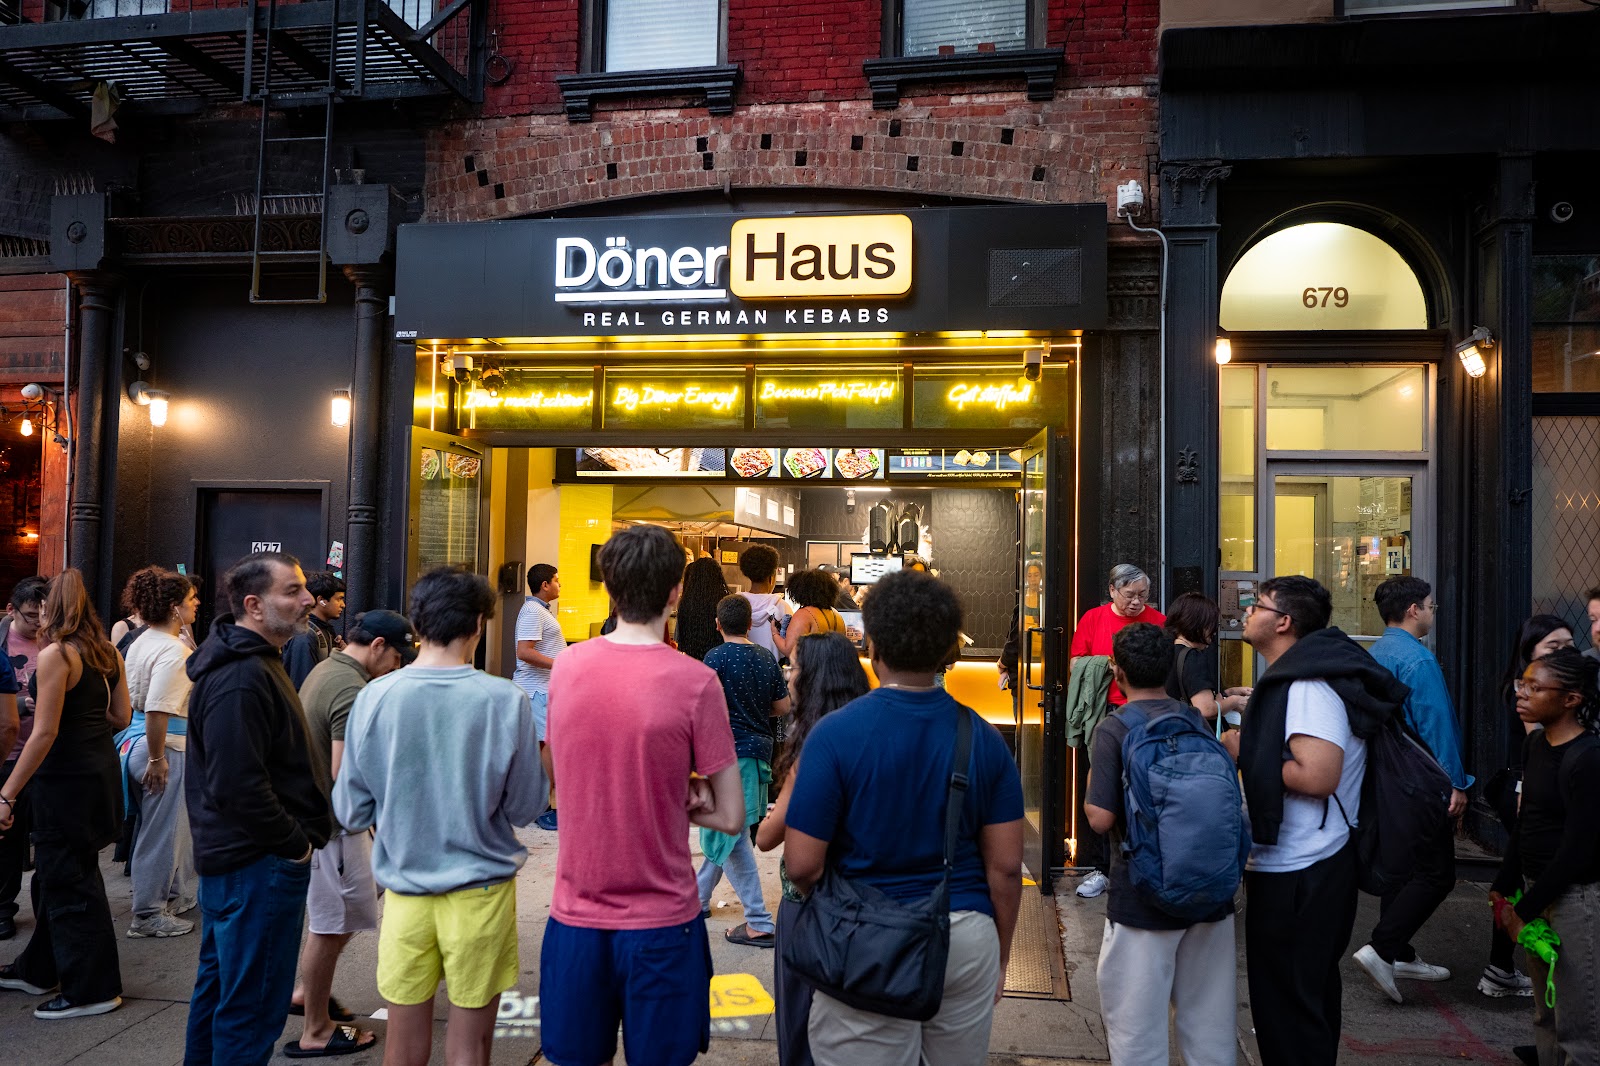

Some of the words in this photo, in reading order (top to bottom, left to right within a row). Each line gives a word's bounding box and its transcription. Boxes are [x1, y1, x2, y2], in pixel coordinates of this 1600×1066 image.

[555, 237, 728, 287] Döner
[746, 232, 896, 282] Haus
[1302, 287, 1349, 308] 679
[583, 311, 645, 326] REAL
[661, 310, 767, 325] GERMAN
[785, 308, 889, 323] KEBABS
[613, 386, 639, 410] Big
[684, 385, 739, 410] Energy!
[760, 382, 819, 400] Because
[253, 543, 280, 553] 677
